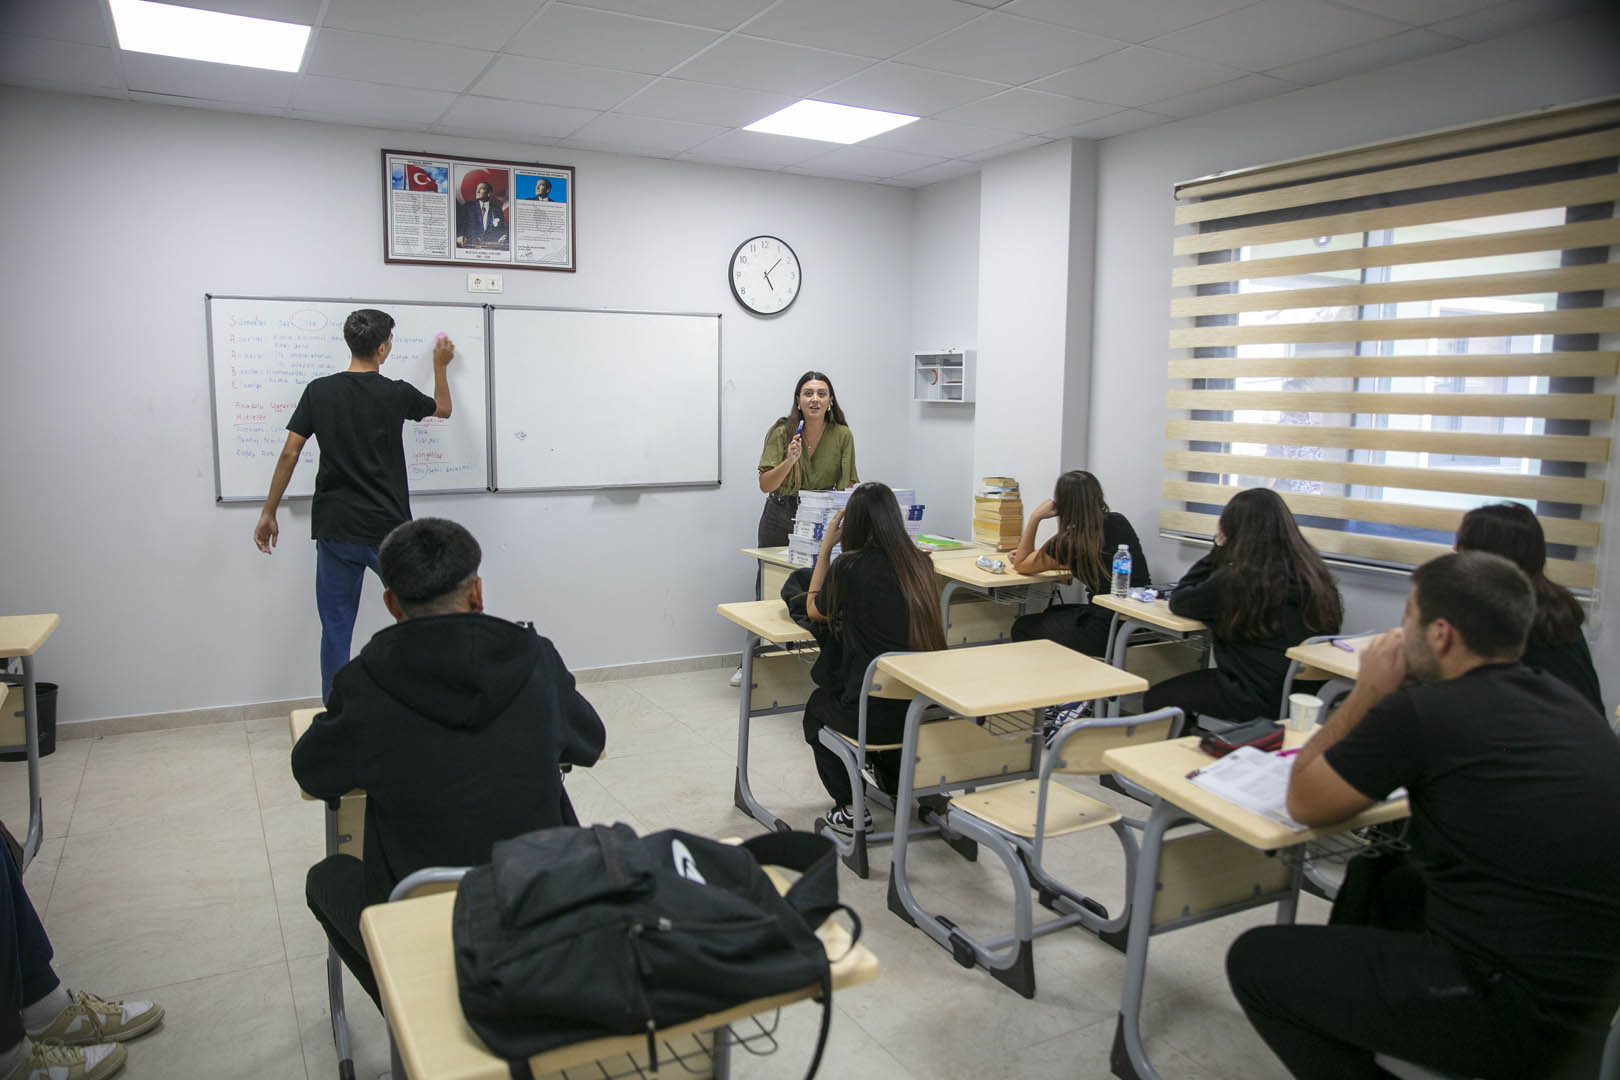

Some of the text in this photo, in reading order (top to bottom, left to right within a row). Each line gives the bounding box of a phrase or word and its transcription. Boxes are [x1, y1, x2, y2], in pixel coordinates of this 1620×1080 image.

[750, 244, 757, 253] 11
[761, 240, 769, 249] 12
[739, 255, 748, 265] 10
[786, 256, 793, 265] 2
[790, 271, 796, 280] 3
[741, 286, 747, 295] 8
